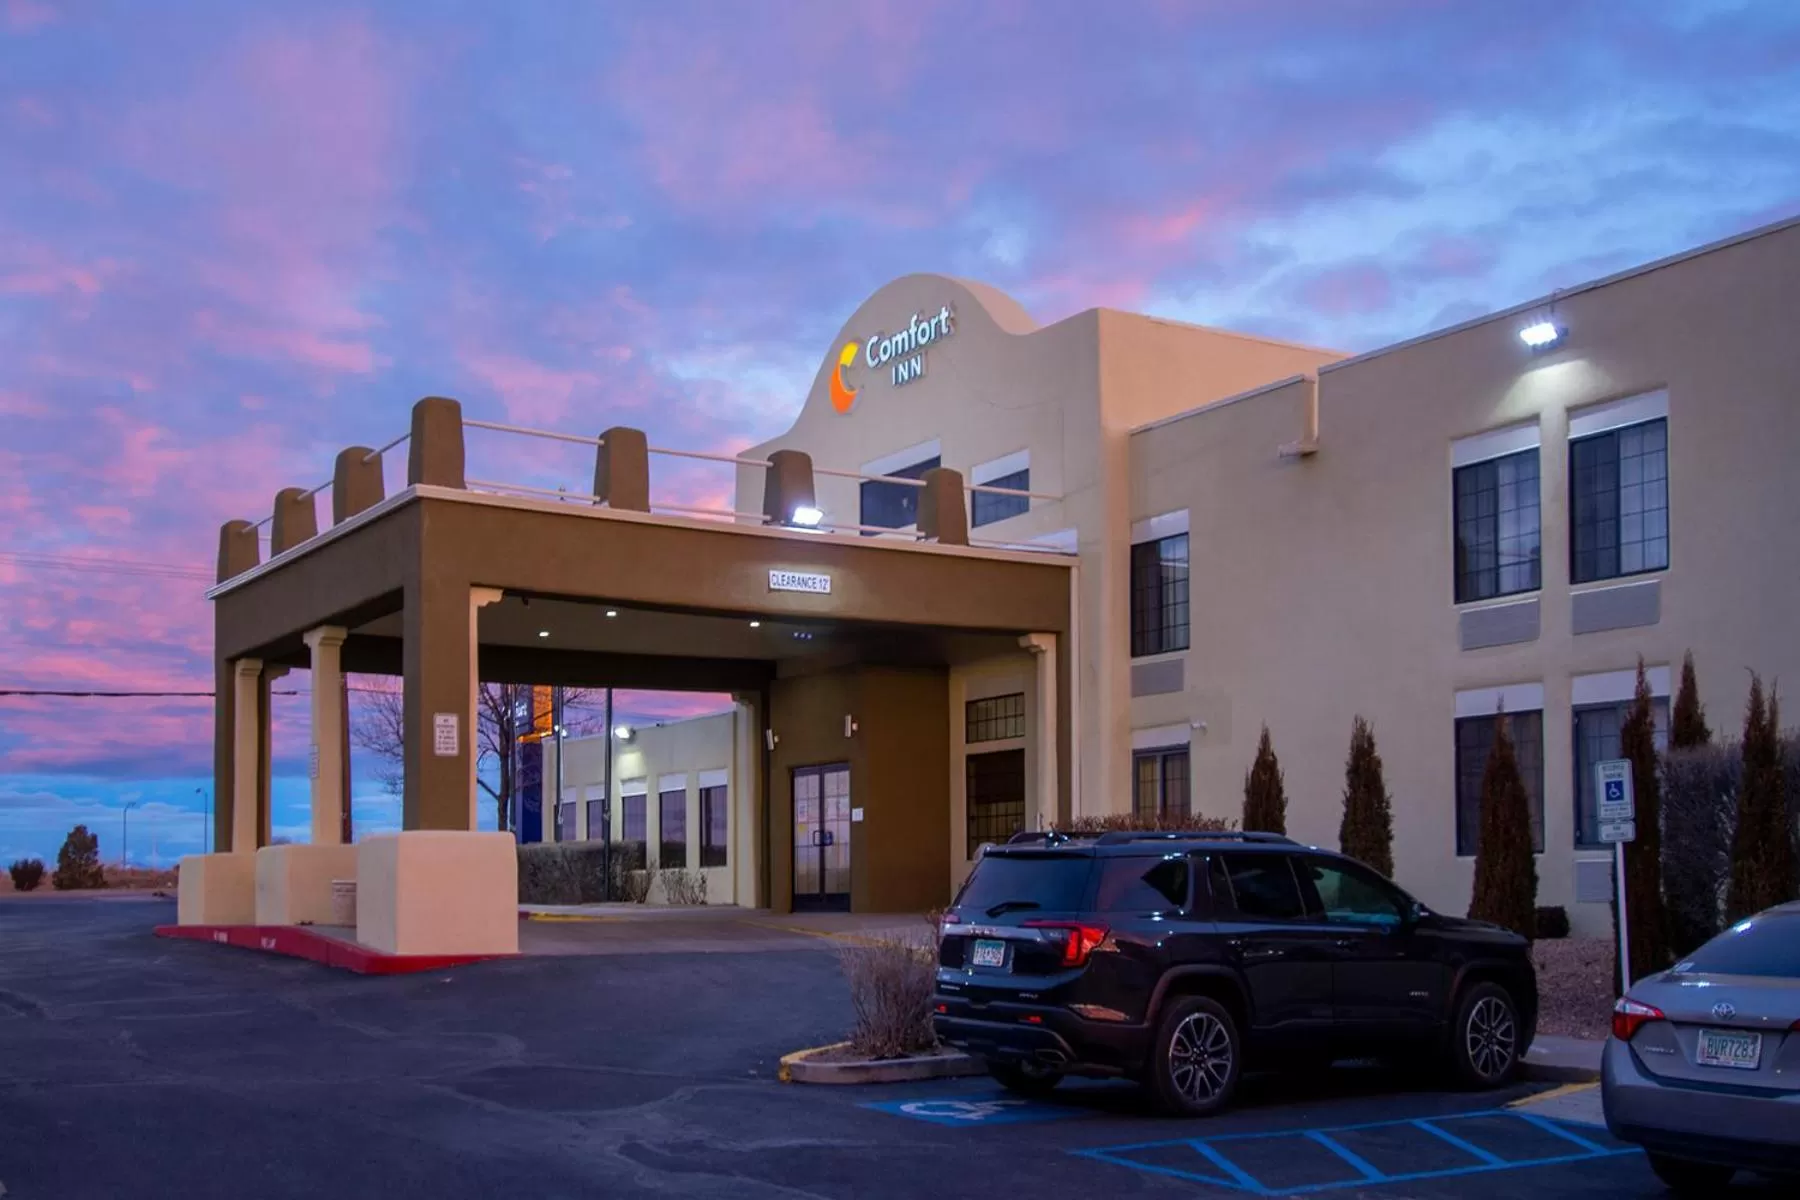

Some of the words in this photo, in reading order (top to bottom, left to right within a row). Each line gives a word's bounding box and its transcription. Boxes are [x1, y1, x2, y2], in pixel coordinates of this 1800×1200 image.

[866, 305, 950, 369] Comfort
[892, 354, 922, 386] INN
[772, 574, 817, 589] CLEARANCE
